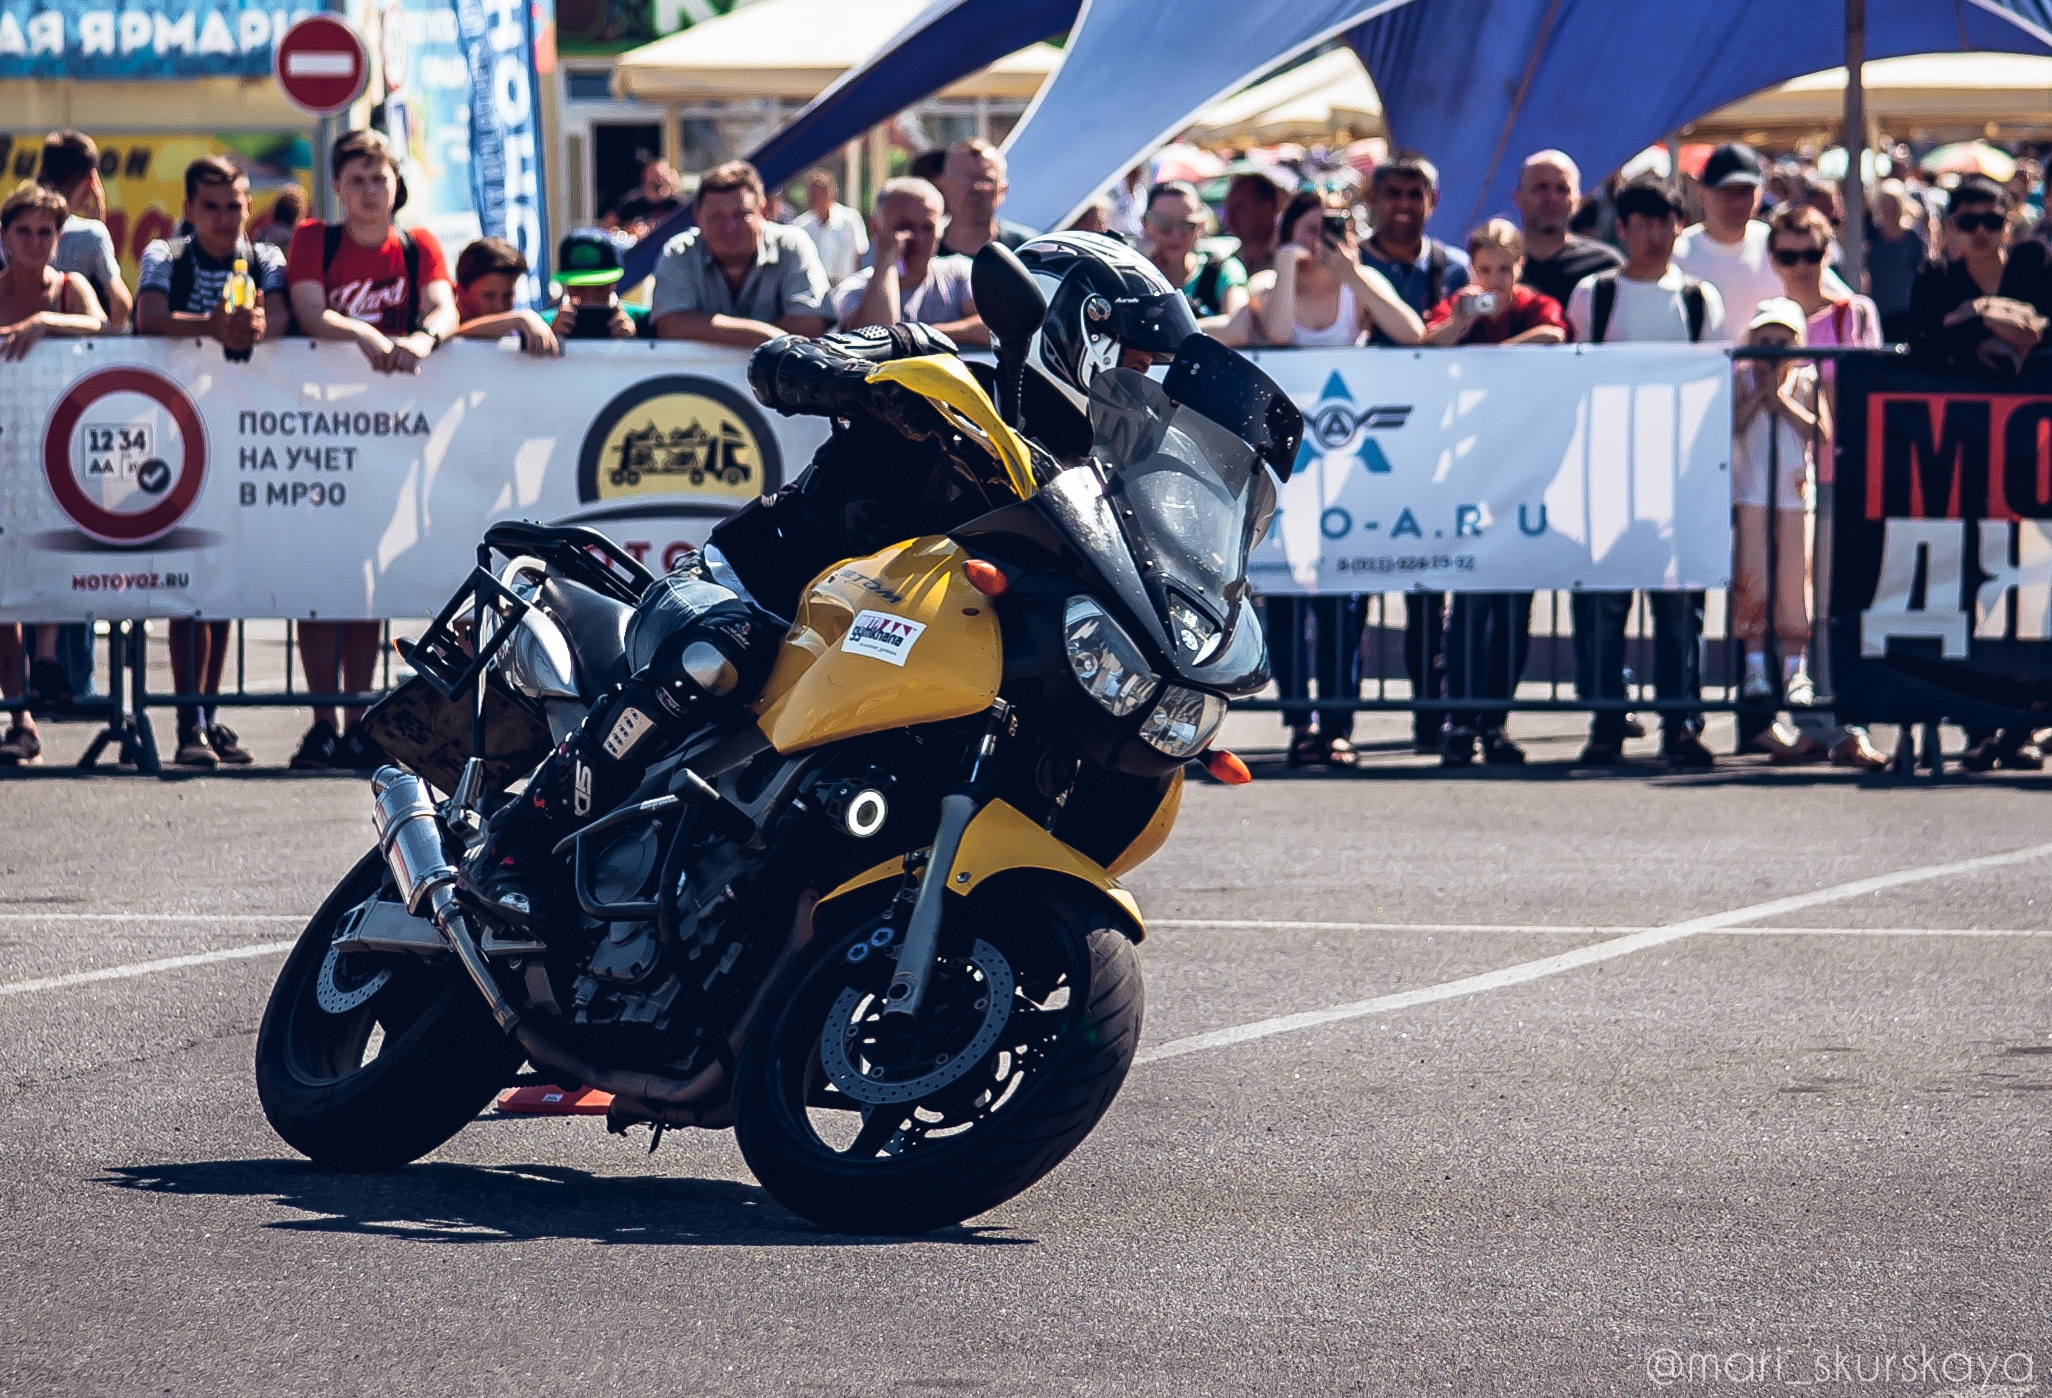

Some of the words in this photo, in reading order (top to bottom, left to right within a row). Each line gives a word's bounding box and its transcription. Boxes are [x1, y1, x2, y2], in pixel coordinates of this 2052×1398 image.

[239, 411, 430, 436] ПОСТАНОВКА
[239, 446, 278, 471] НА
[285, 446, 356, 472] УЧЕТ
[239, 481, 257, 507] В
